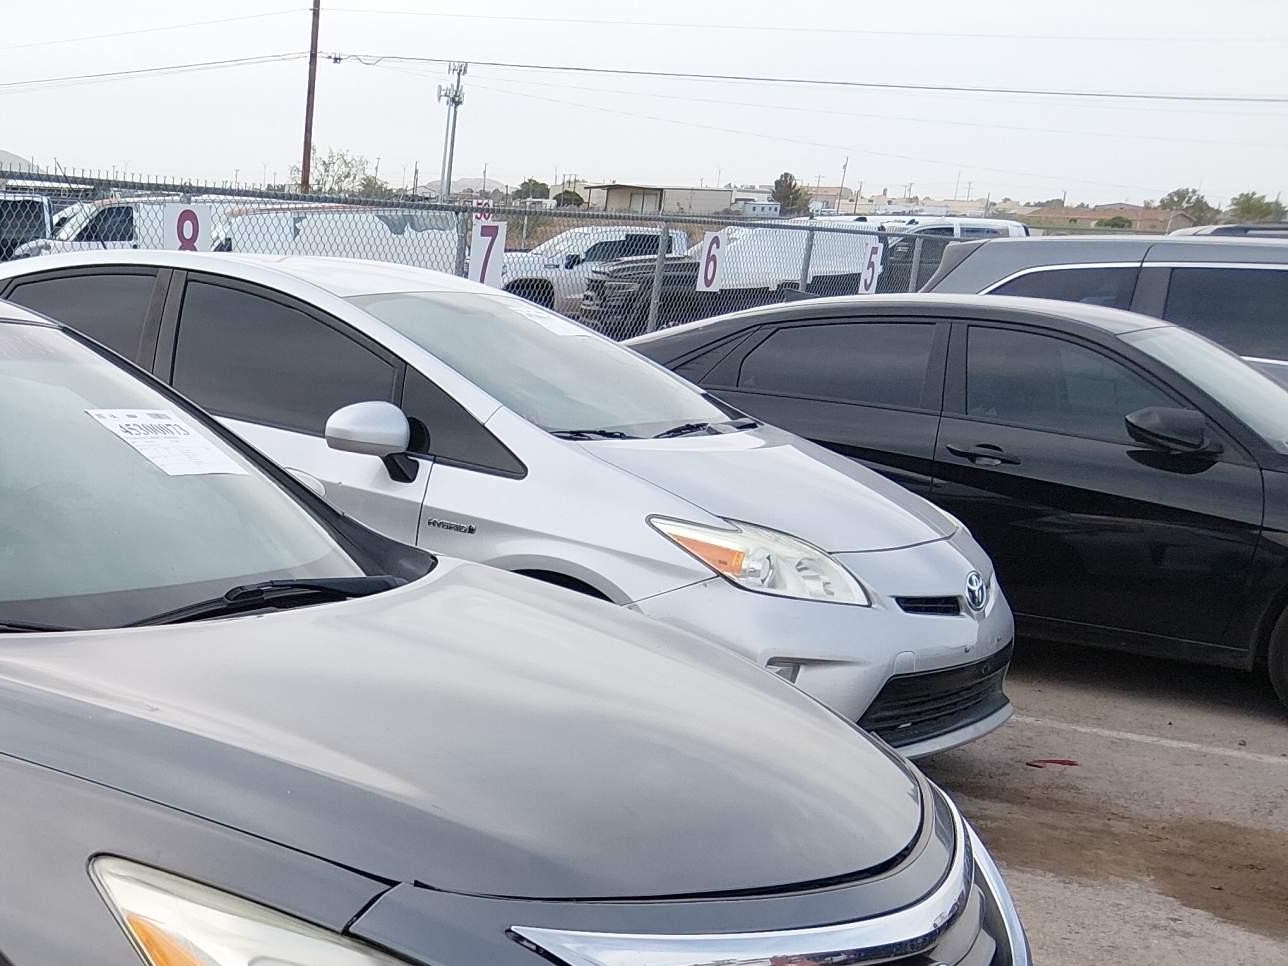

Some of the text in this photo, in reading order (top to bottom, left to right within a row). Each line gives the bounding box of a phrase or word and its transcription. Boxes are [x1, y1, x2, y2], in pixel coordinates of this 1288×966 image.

[480, 225, 499, 284] 7
[703, 236, 720, 288] 6
[864, 246, 878, 291] 5
